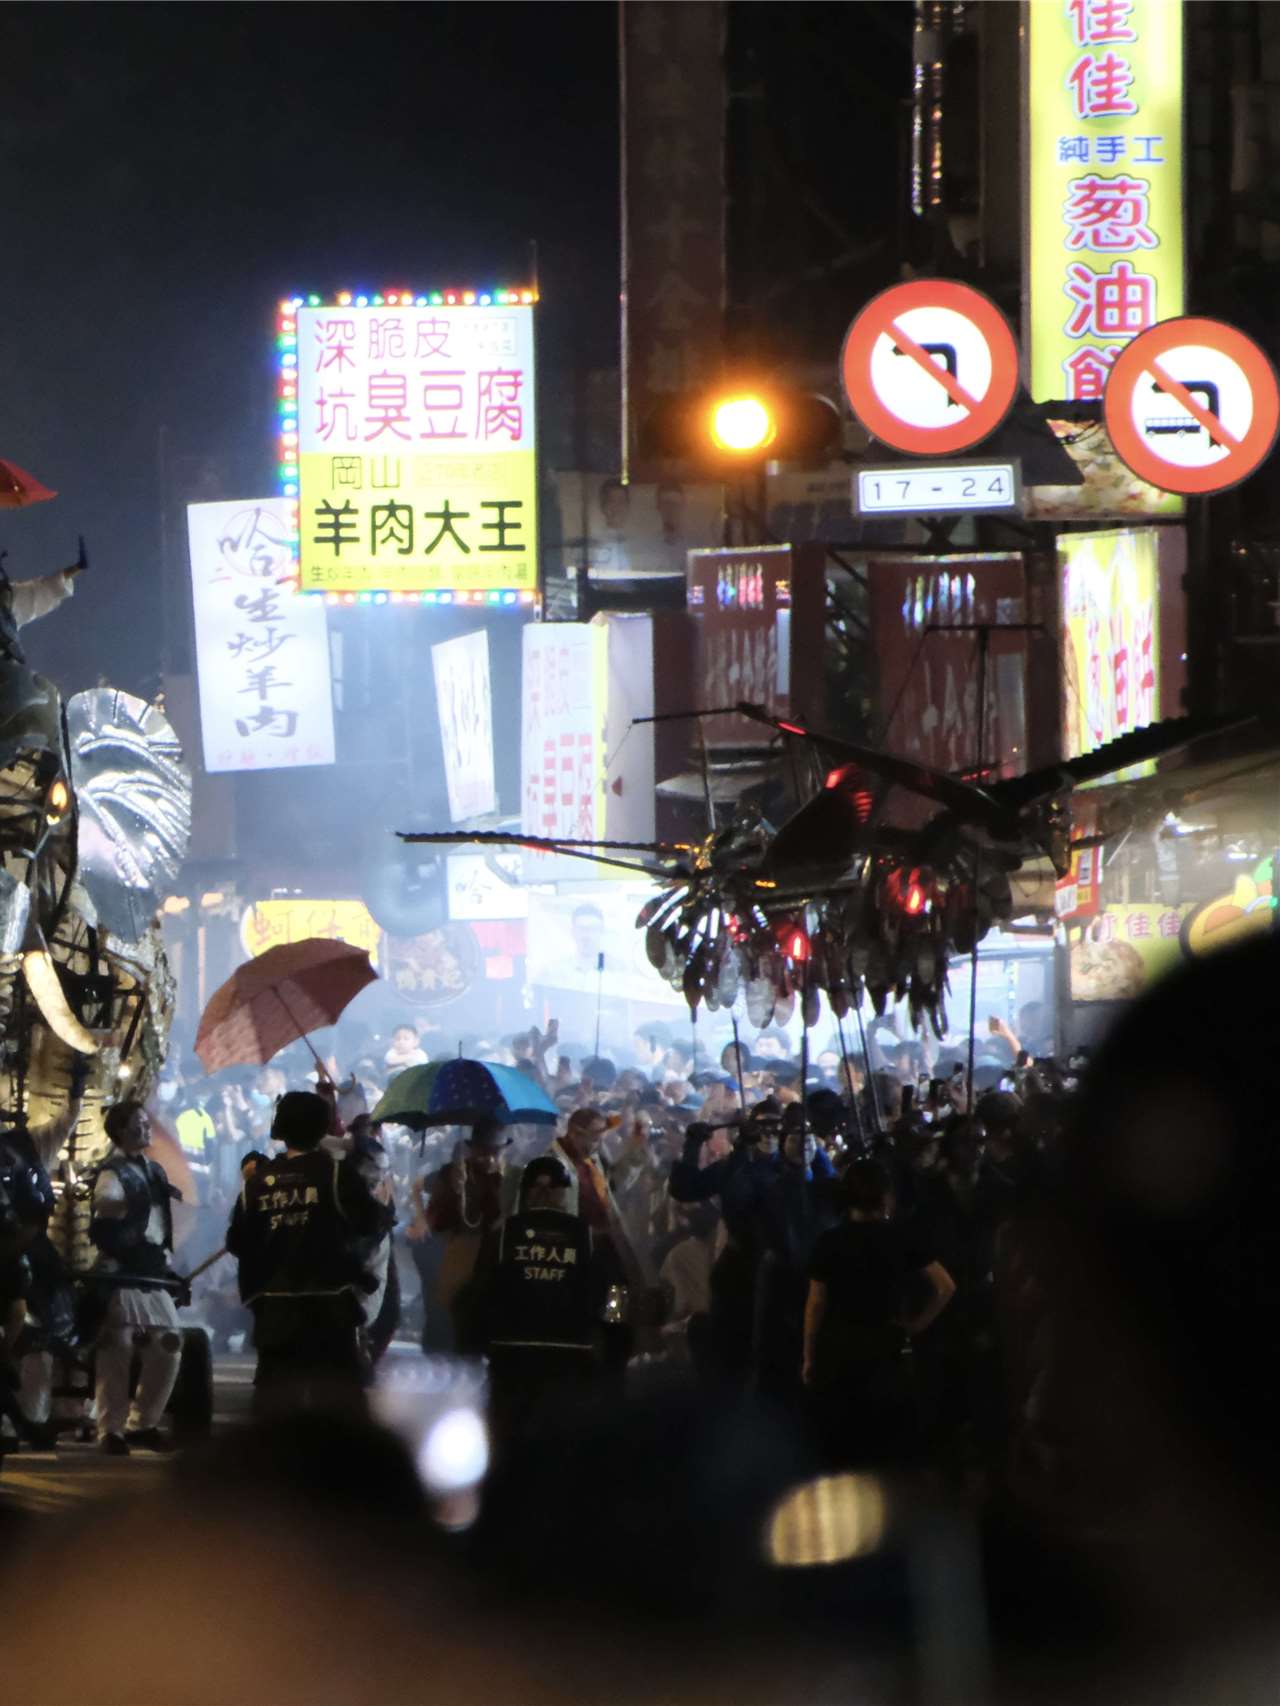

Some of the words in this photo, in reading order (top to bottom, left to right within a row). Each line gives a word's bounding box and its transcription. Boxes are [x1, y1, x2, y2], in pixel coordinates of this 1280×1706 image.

[1058, 136, 1165, 164] 純手工
[368, 317, 452, 360] 脆皮
[364, 367, 524, 442] 臭豆腐
[332, 456, 401, 490] 岡山
[314, 499, 527, 557] 羊肉大王
[257, 1186, 319, 1212] 工作人員
[513, 1244, 577, 1265] 工作人員
[524, 1266, 566, 1281] STAFF
